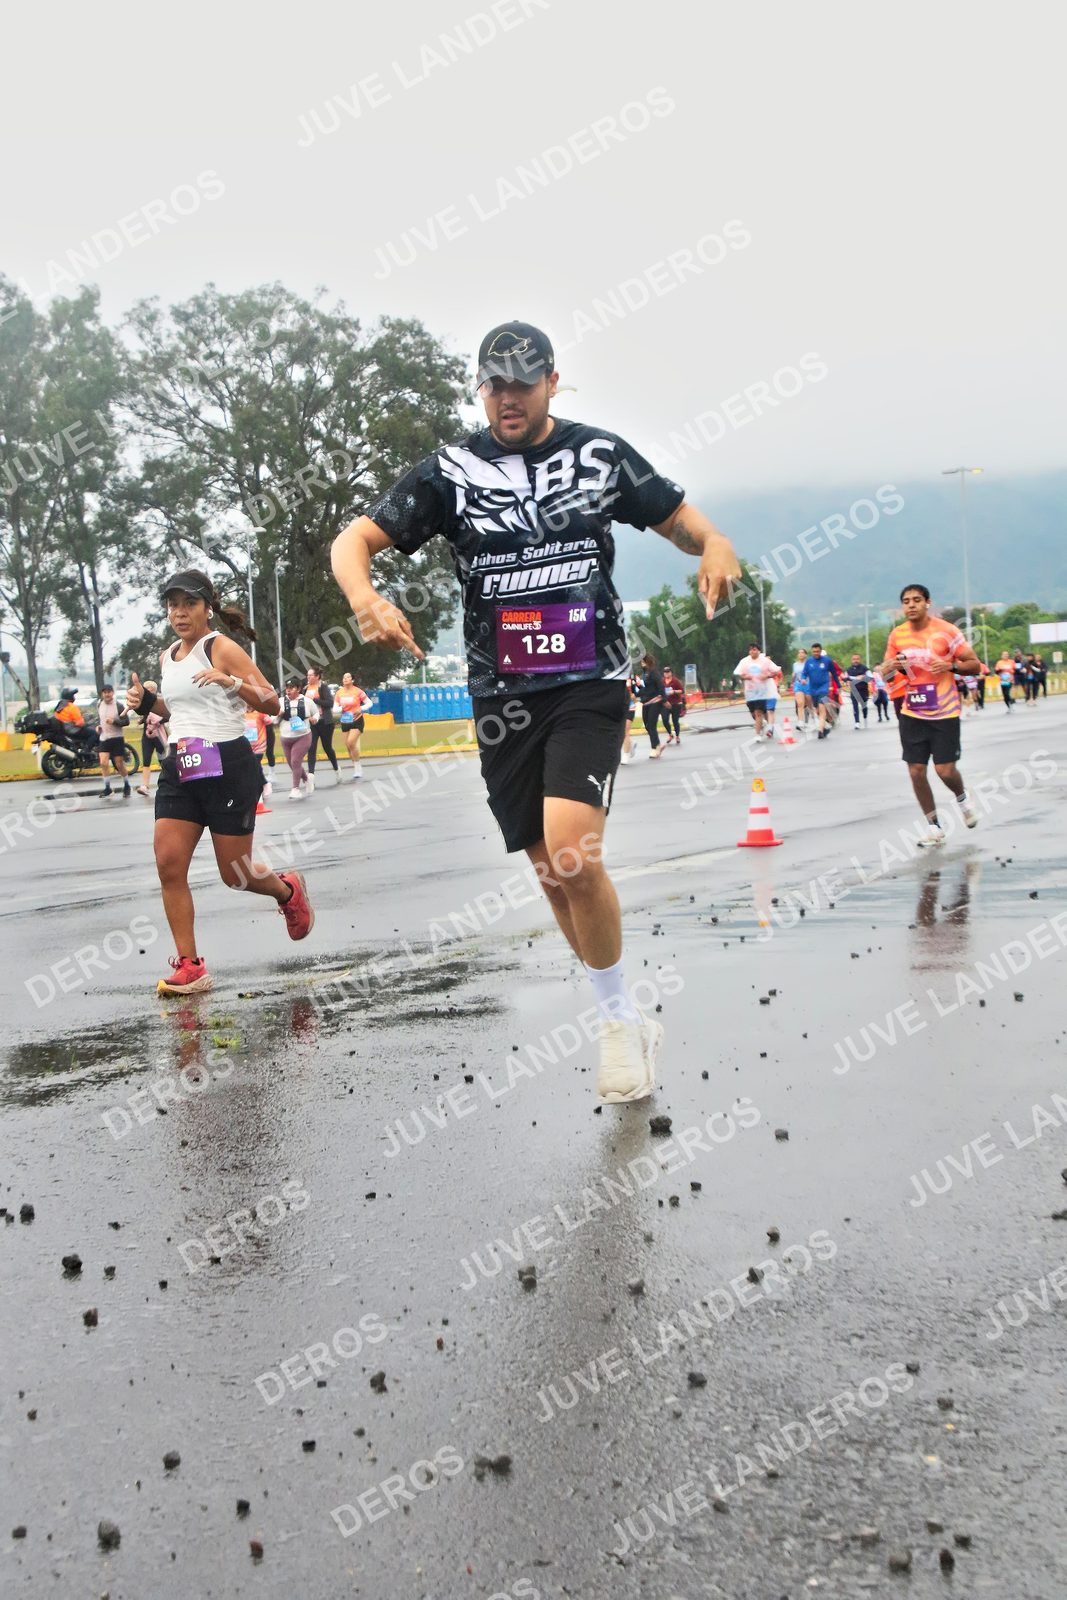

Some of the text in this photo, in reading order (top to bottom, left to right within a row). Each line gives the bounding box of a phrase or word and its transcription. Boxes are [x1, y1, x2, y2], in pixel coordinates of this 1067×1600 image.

[532, 438, 616, 502] BS
[482, 558, 598, 594] runner
[502, 611, 542, 622] CARRERA
[568, 608, 588, 622] 15K
[521, 633, 566, 654] 128
[180, 753, 202, 768] 189
